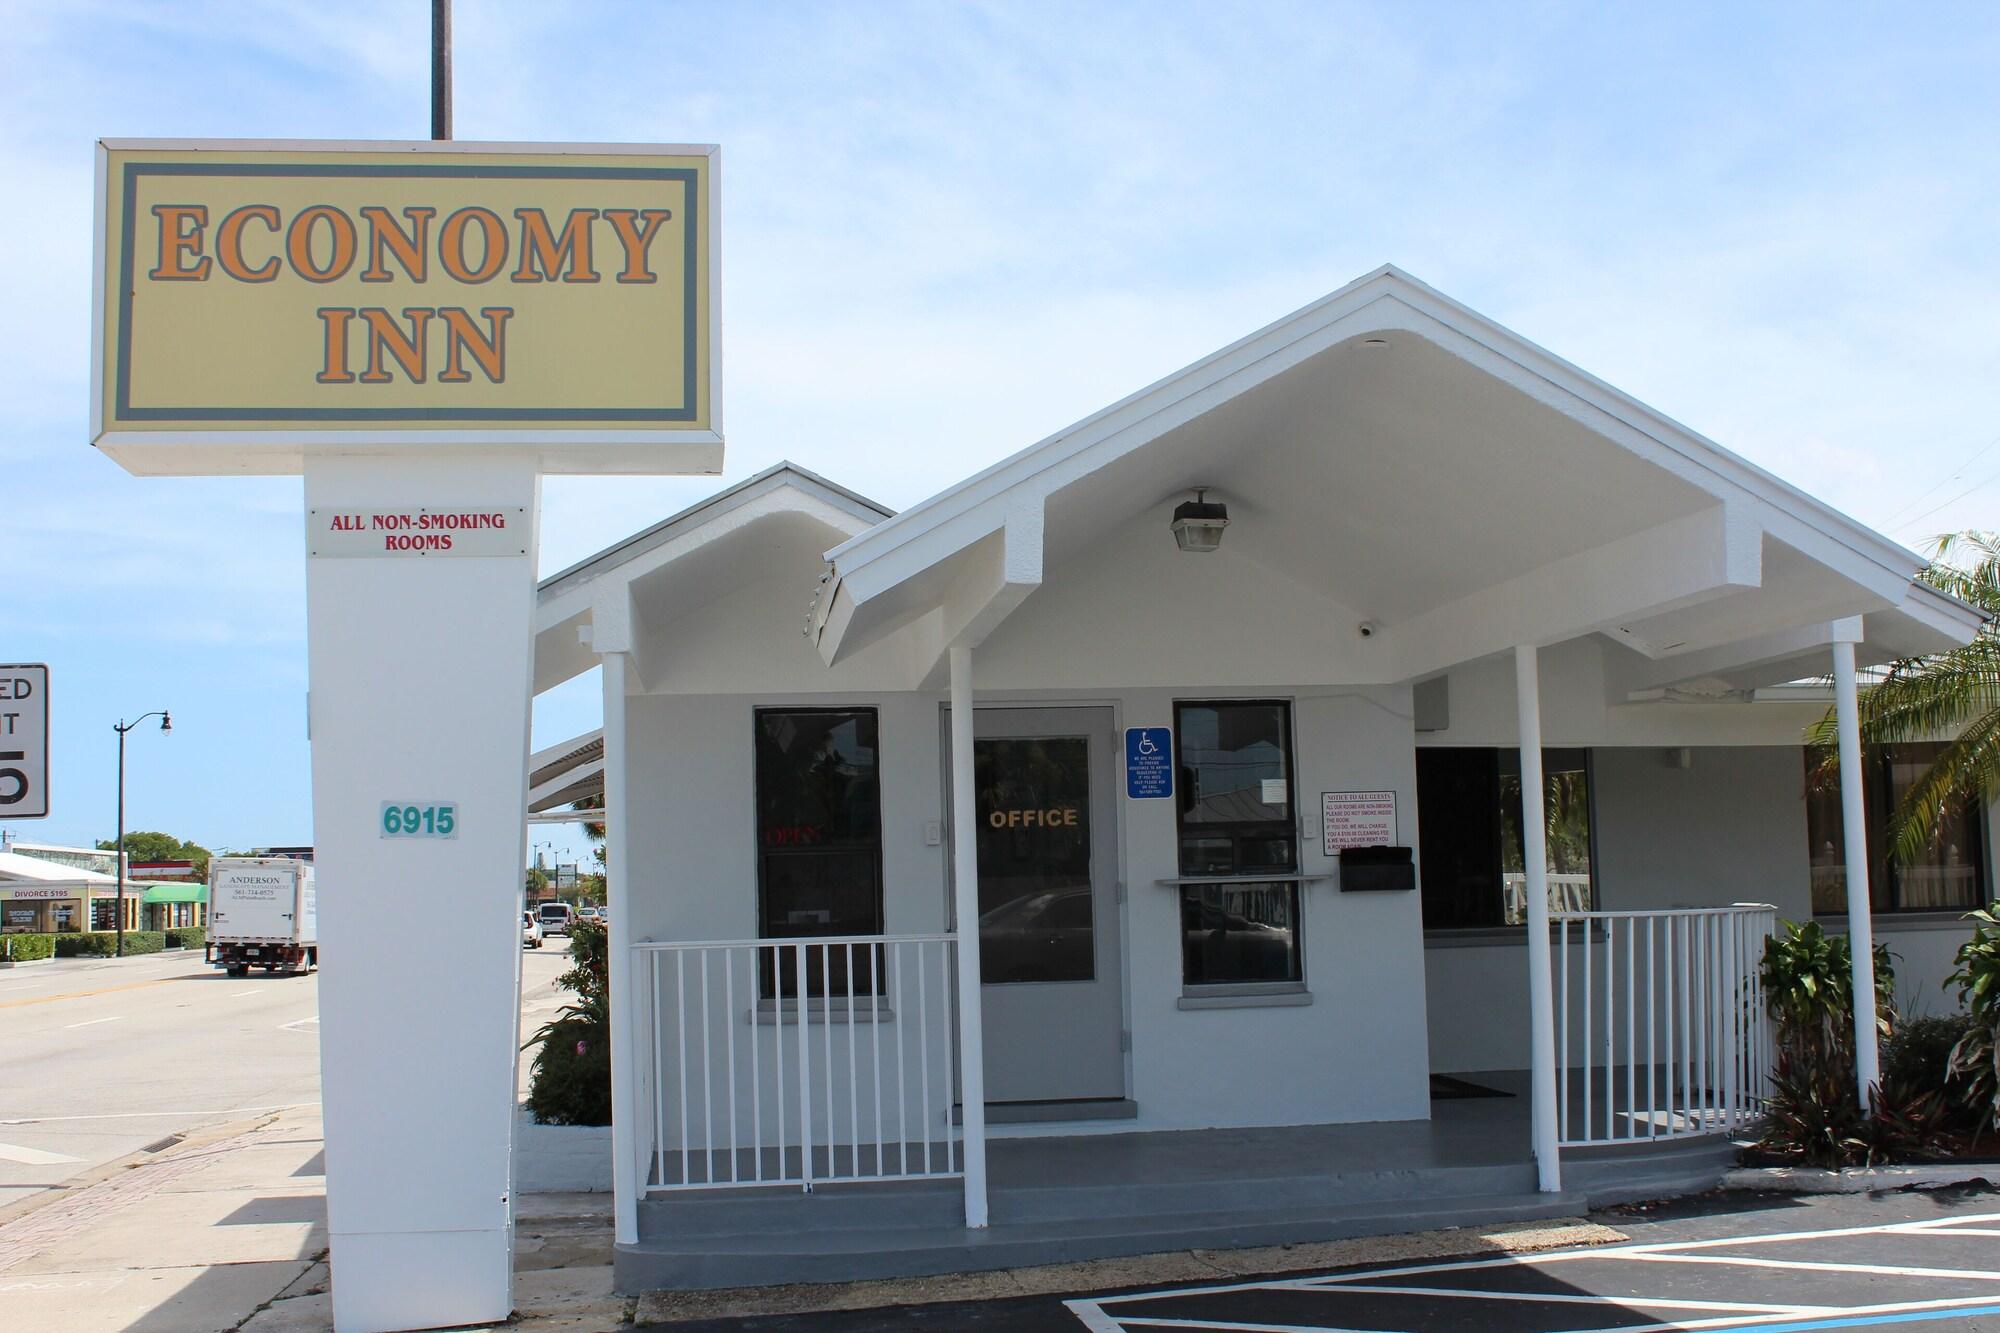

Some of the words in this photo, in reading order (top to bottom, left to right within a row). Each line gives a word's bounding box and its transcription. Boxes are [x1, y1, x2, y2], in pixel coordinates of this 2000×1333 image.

[148, 204, 672, 284] ECONOMY
[316, 306, 515, 384] INN
[330, 515, 365, 530] ALL
[372, 513, 505, 530] NON-SMOKING
[385, 535, 452, 550] ROOMS
[384, 806, 454, 834] 6915
[990, 809, 1078, 828] OFFICE
